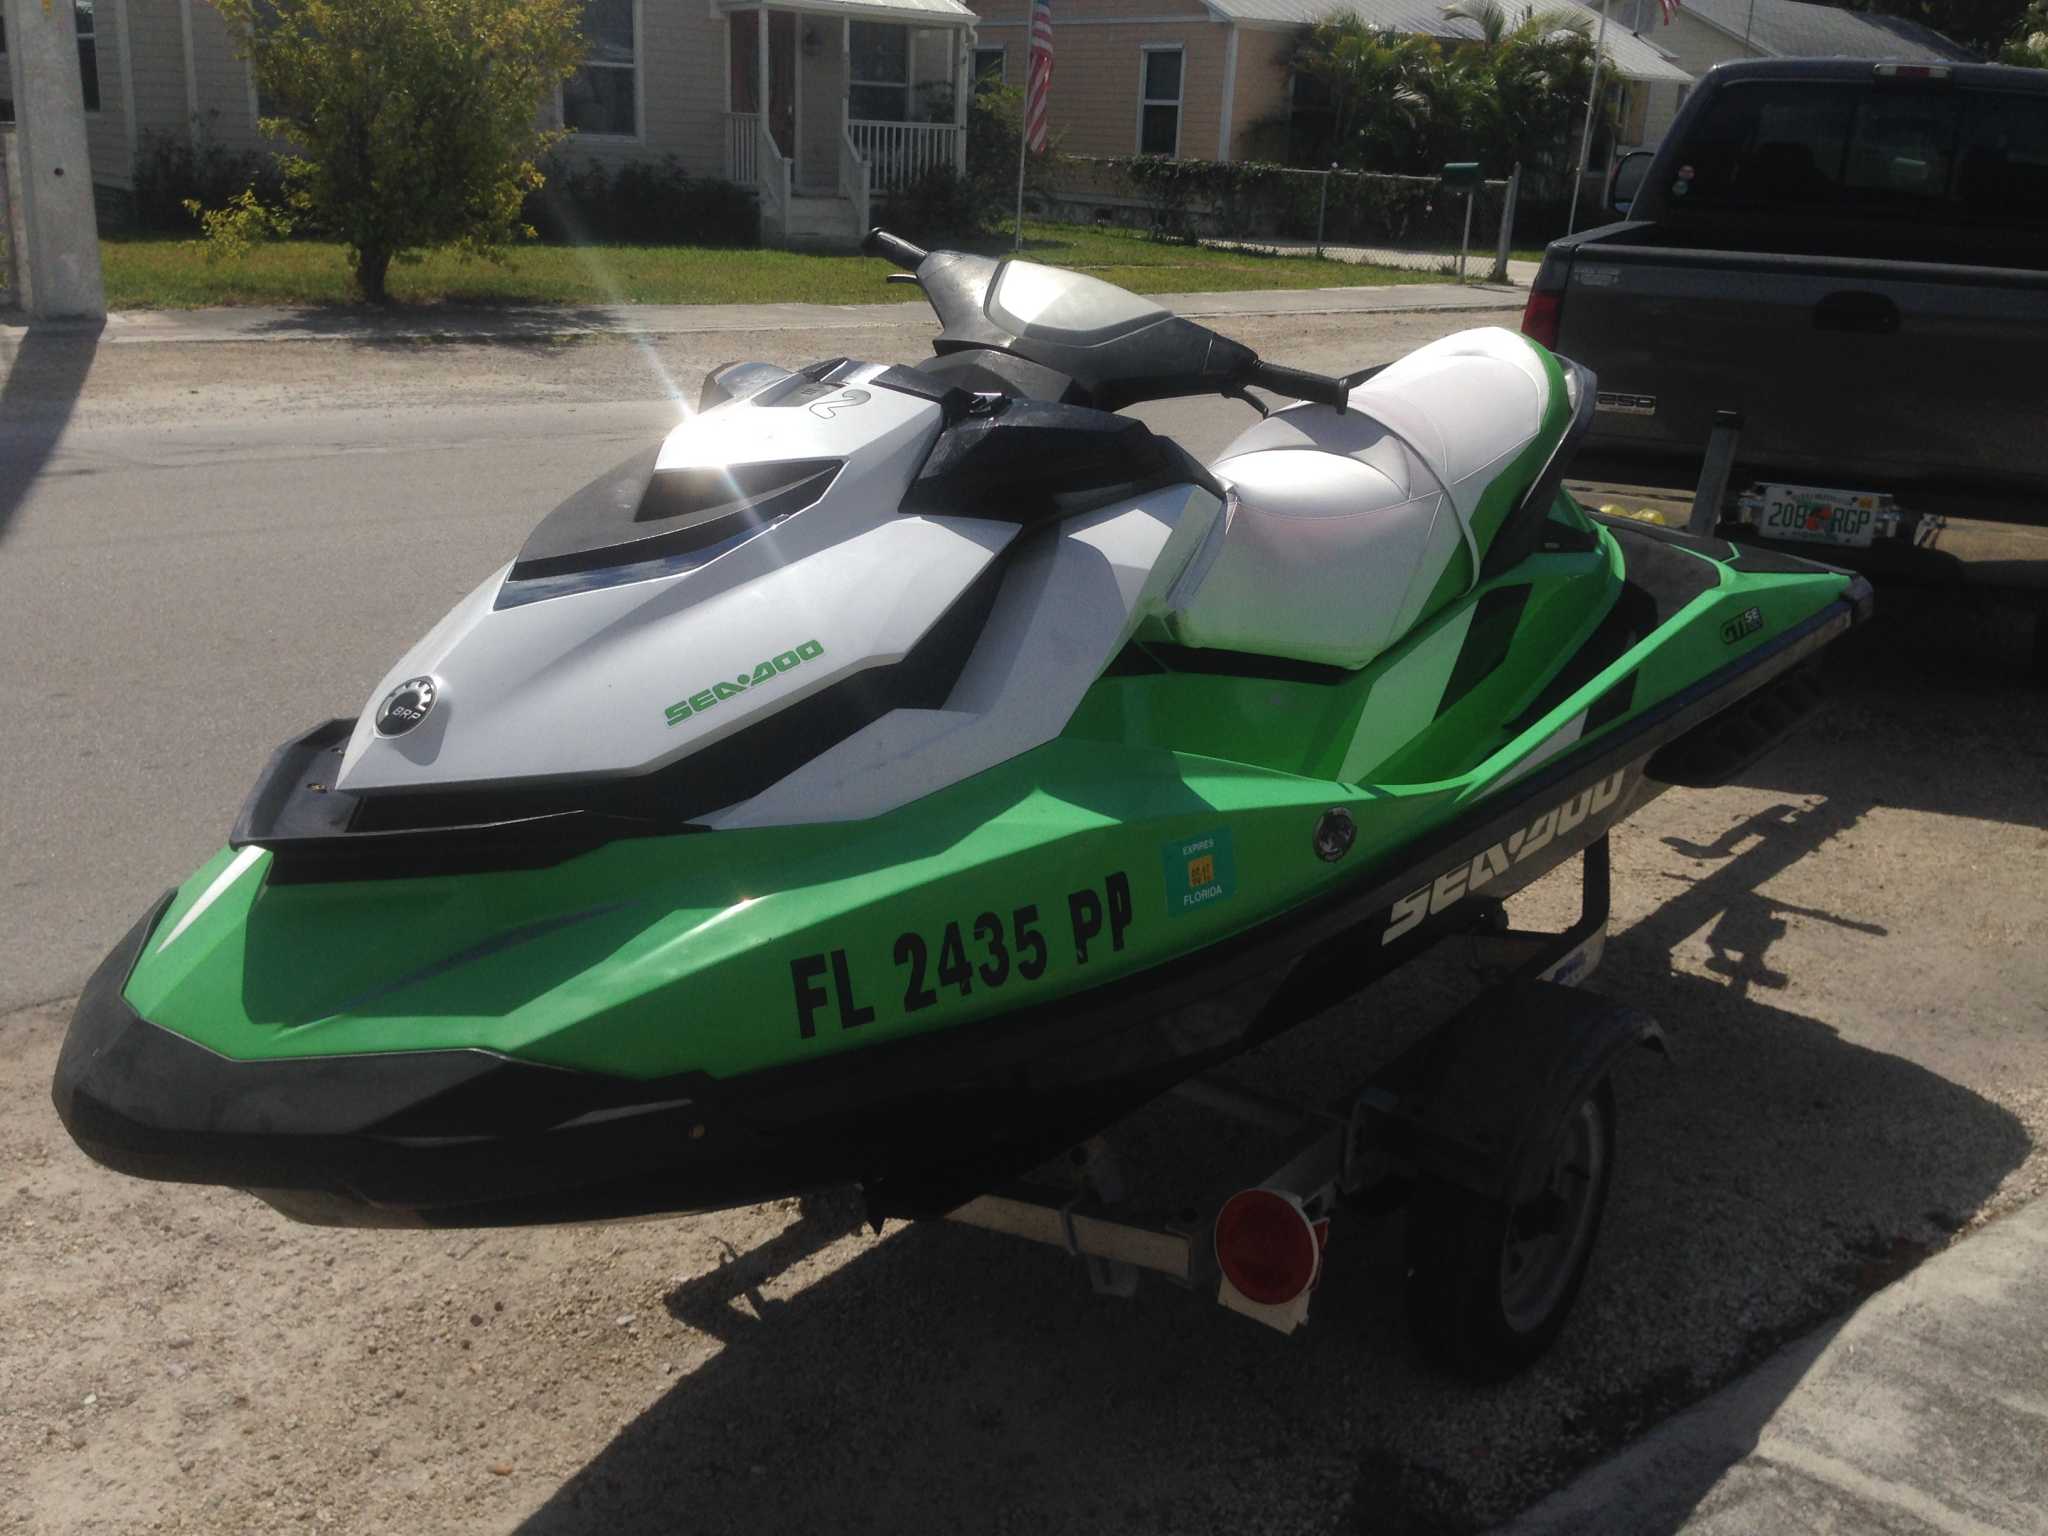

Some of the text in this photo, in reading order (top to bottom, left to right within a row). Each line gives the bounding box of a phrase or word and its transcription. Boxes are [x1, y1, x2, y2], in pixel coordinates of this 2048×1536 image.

[1831, 507, 1871, 535] RGP
[392, 706, 422, 720] BRP
[1183, 884, 1222, 906] FLORIDA
[790, 870, 1134, 1040] FL 2435 PP
